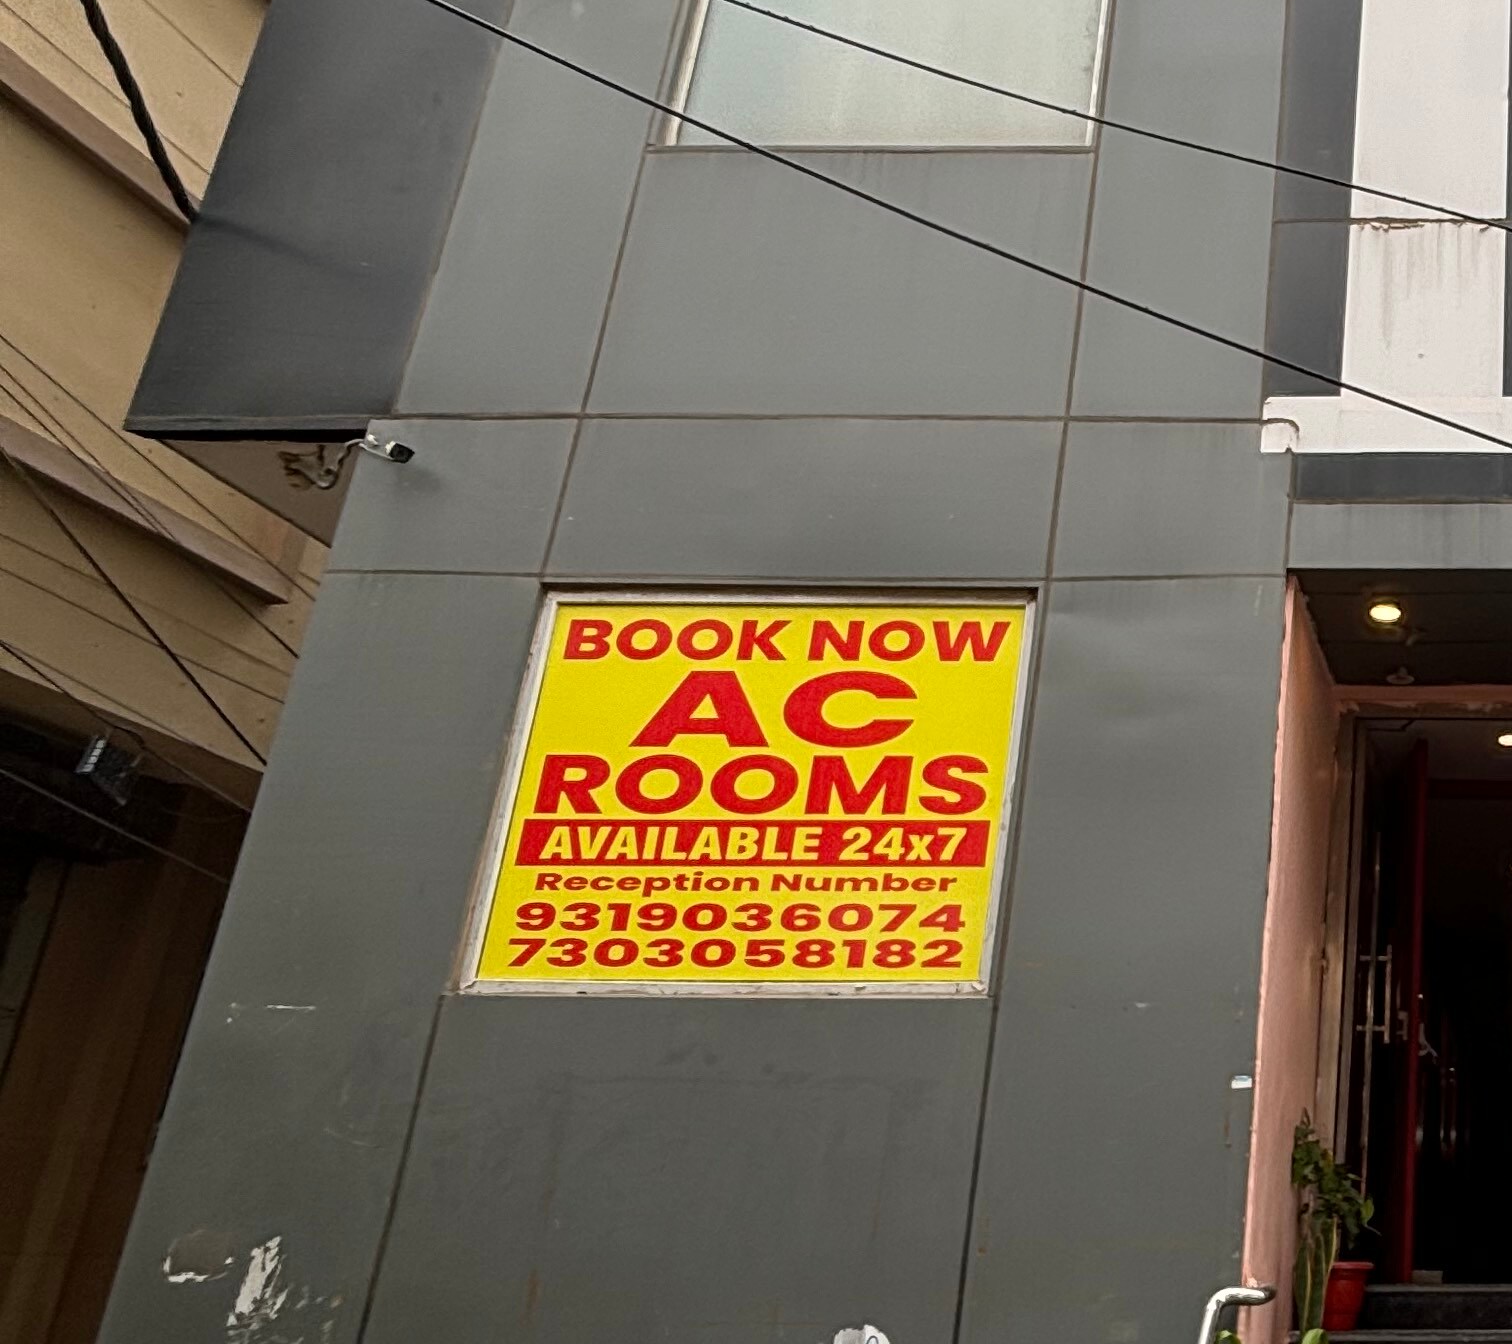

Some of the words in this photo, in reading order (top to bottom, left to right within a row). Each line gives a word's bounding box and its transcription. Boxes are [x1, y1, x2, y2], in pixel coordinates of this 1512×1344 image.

[563, 619, 792, 661] BOOK
[807, 620, 1011, 662] NOW
[629, 670, 918, 748] AC
[533, 754, 989, 815] ROOMS
[539, 826, 822, 861] AVAILABLE
[841, 826, 968, 860] 24x7
[535, 872, 760, 898] Reception
[770, 873, 958, 893] Number
[514, 902, 966, 933] 9319036074
[507, 938, 965, 969] 7303058182
